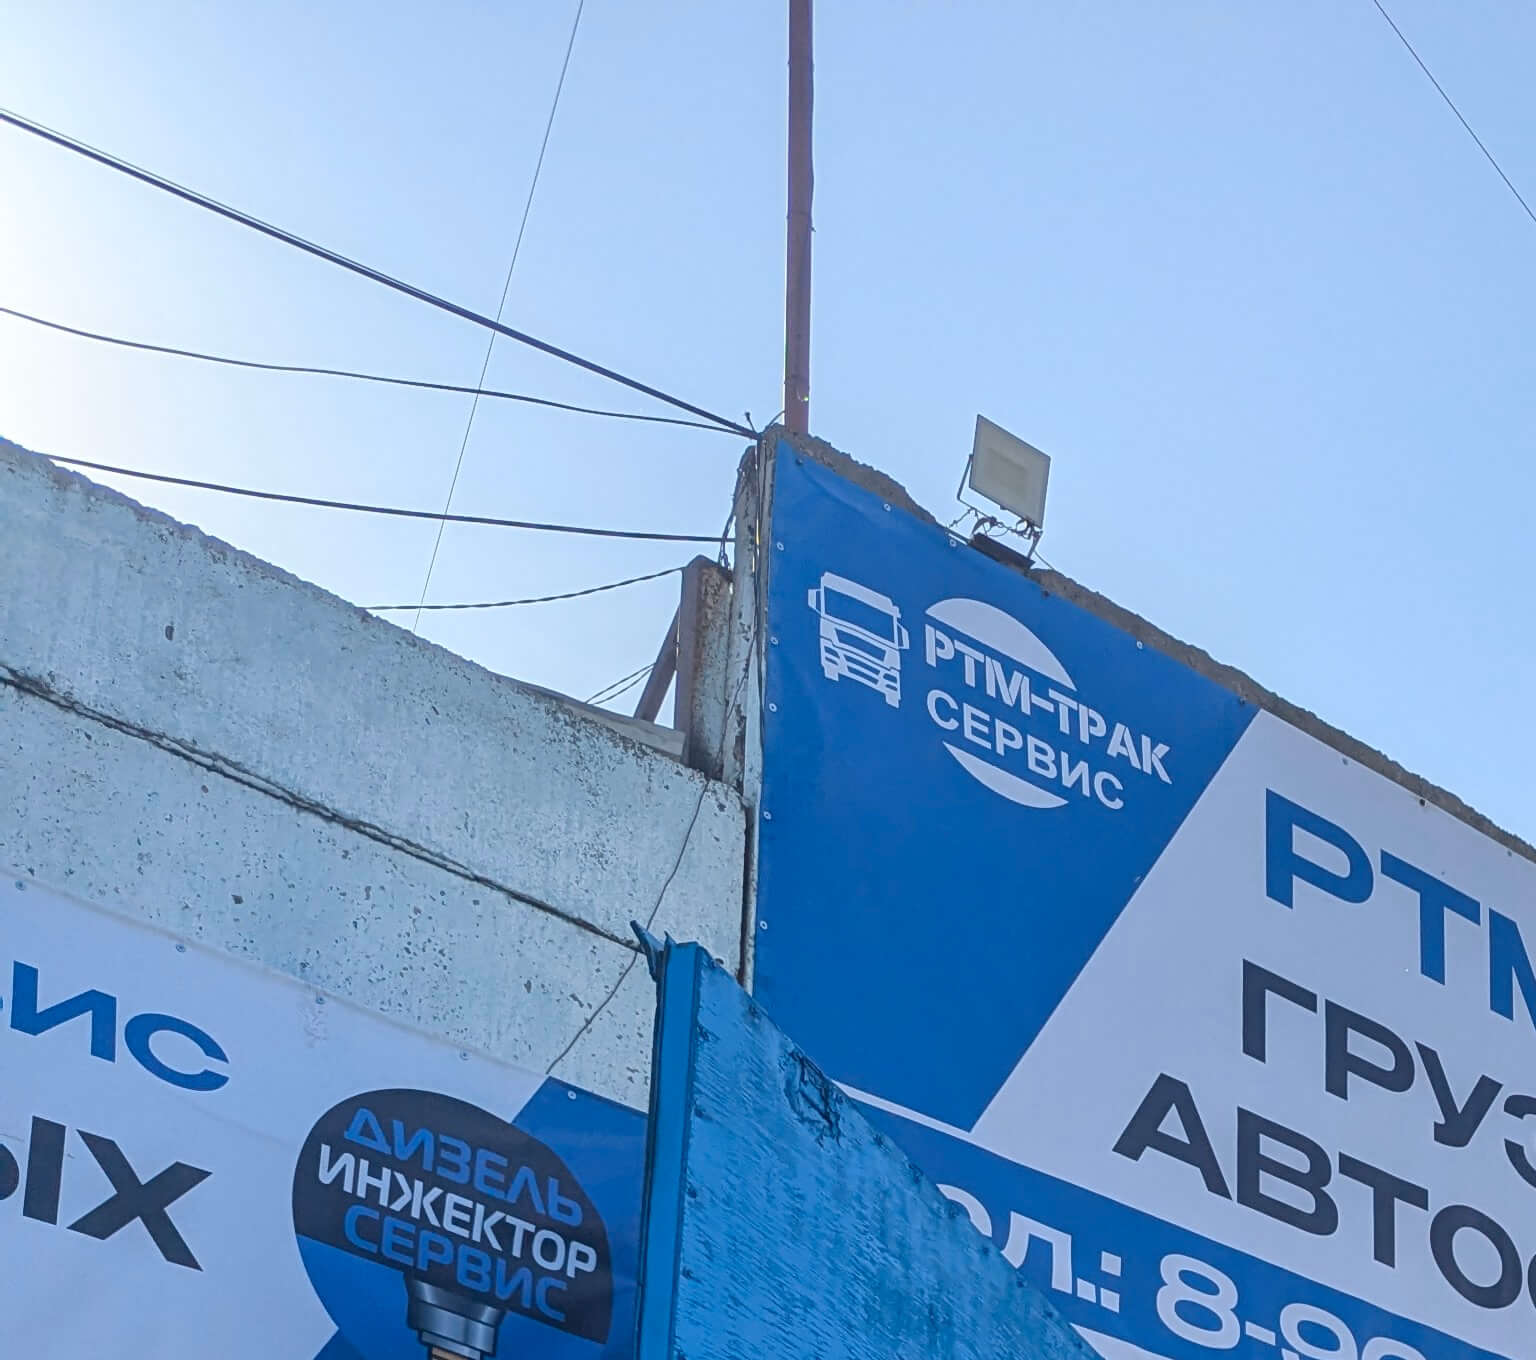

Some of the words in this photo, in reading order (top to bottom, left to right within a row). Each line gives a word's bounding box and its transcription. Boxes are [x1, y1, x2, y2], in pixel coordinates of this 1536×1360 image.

[925, 623, 1173, 785] РТМ-ТРАК
[925, 688, 1125, 810] СЕРВИС
[0, 959, 230, 1092] ИС
[318, 1143, 598, 1279] ИНЖЕКТОР
[343, 1106, 584, 1228] ДИЗЕЛЬ
[344, 1204, 570, 1323] СЕРВИС
